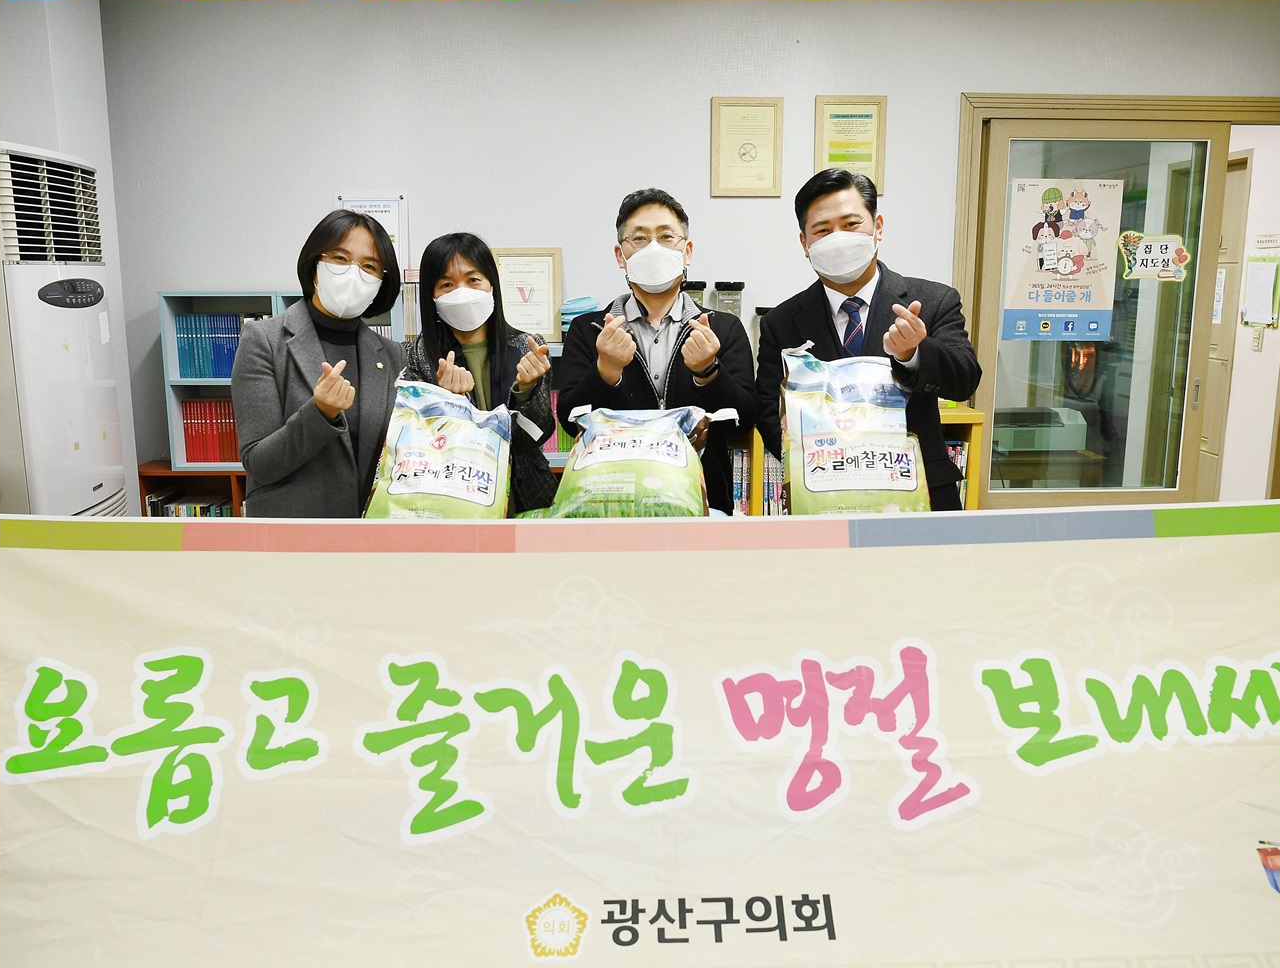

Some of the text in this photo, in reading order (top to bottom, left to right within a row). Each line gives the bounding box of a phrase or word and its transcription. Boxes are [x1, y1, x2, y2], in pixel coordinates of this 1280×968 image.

[1139, 258, 1170, 269] 지도실
[1028, 290, 1092, 303] 다 들어줄 개
[5, 654, 320, 829] 요롭고
[363, 659, 689, 834] 즐거운
[722, 646, 971, 821] 명절
[600, 894, 837, 947] 광산구의회
